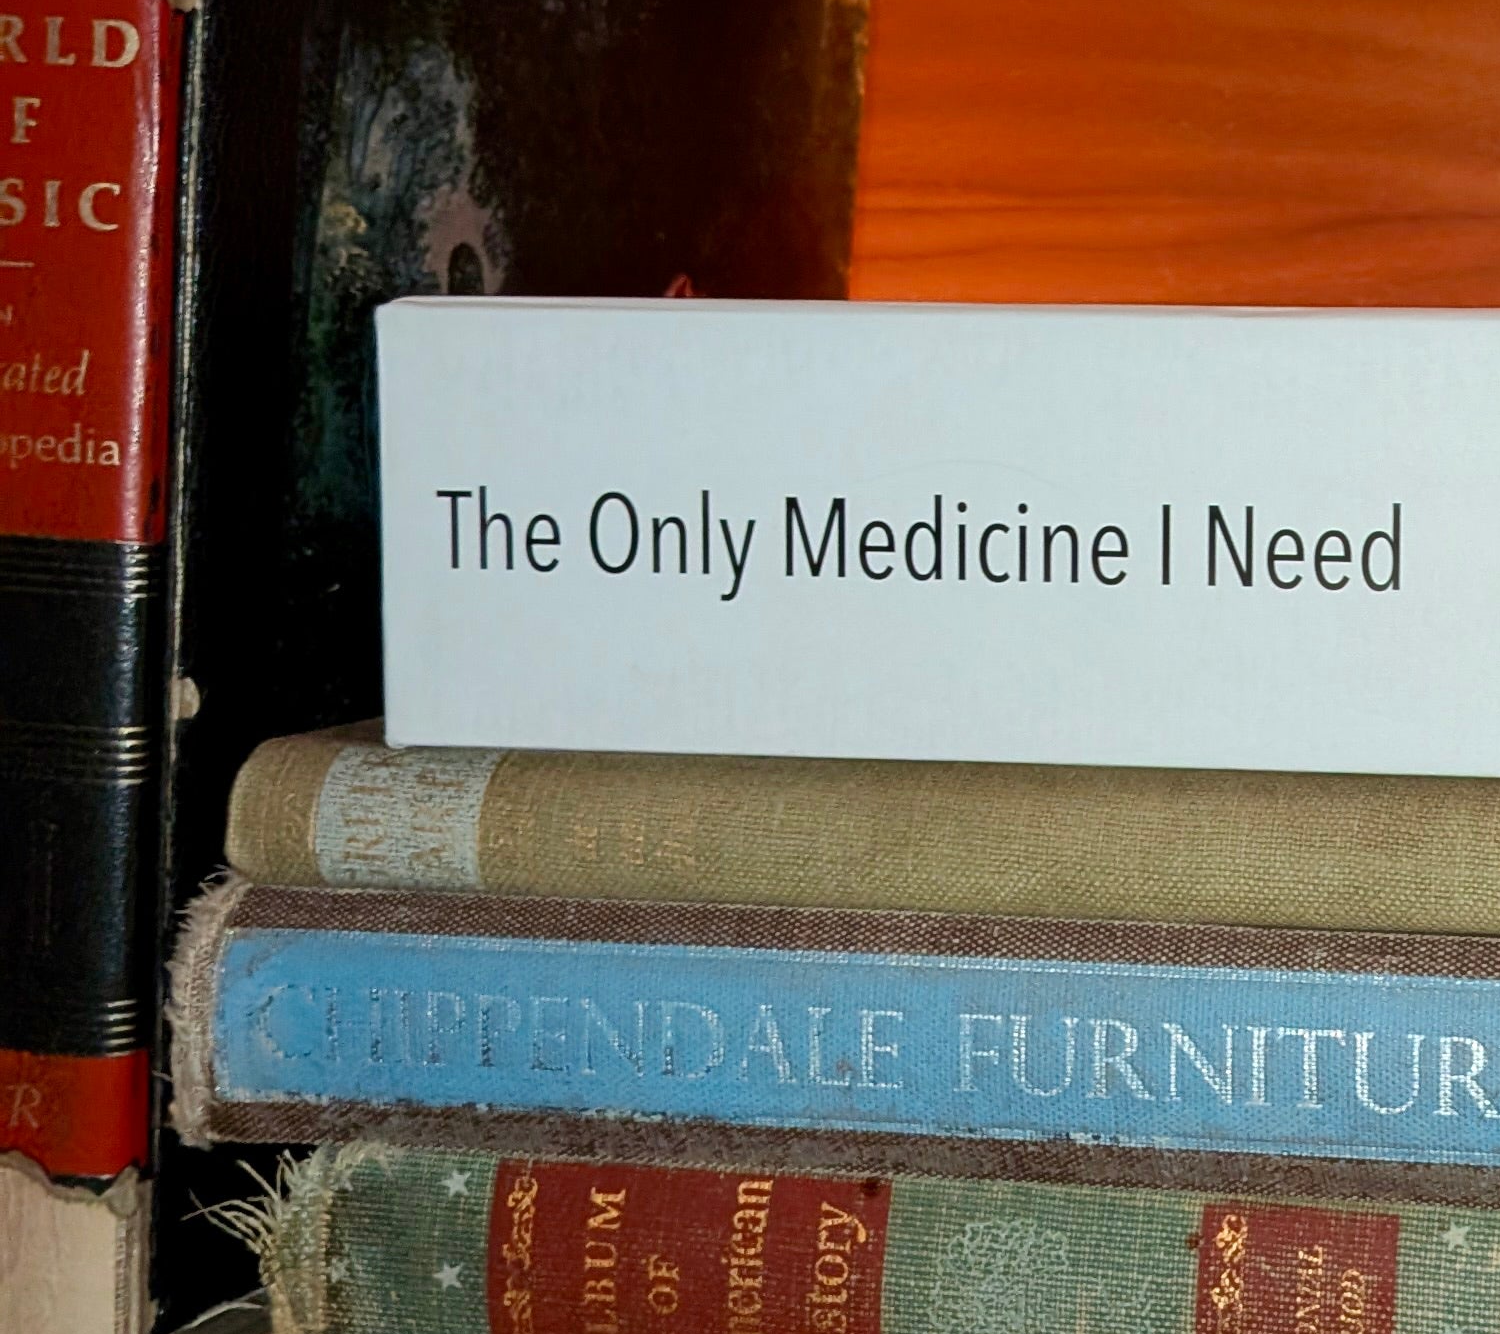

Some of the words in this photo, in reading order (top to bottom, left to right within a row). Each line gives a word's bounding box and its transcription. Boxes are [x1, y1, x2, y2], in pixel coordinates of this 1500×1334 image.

[0, 178, 121, 231] SIC
[0, 348, 91, 396] ated
[436, 486, 561, 573] The
[588, 489, 756, 601] Only
[784, 494, 1130, 585] Medicine
[1161, 504, 1170, 585] I
[1207, 502, 1402, 592] Need
[646, 1254, 680, 1316] OF
